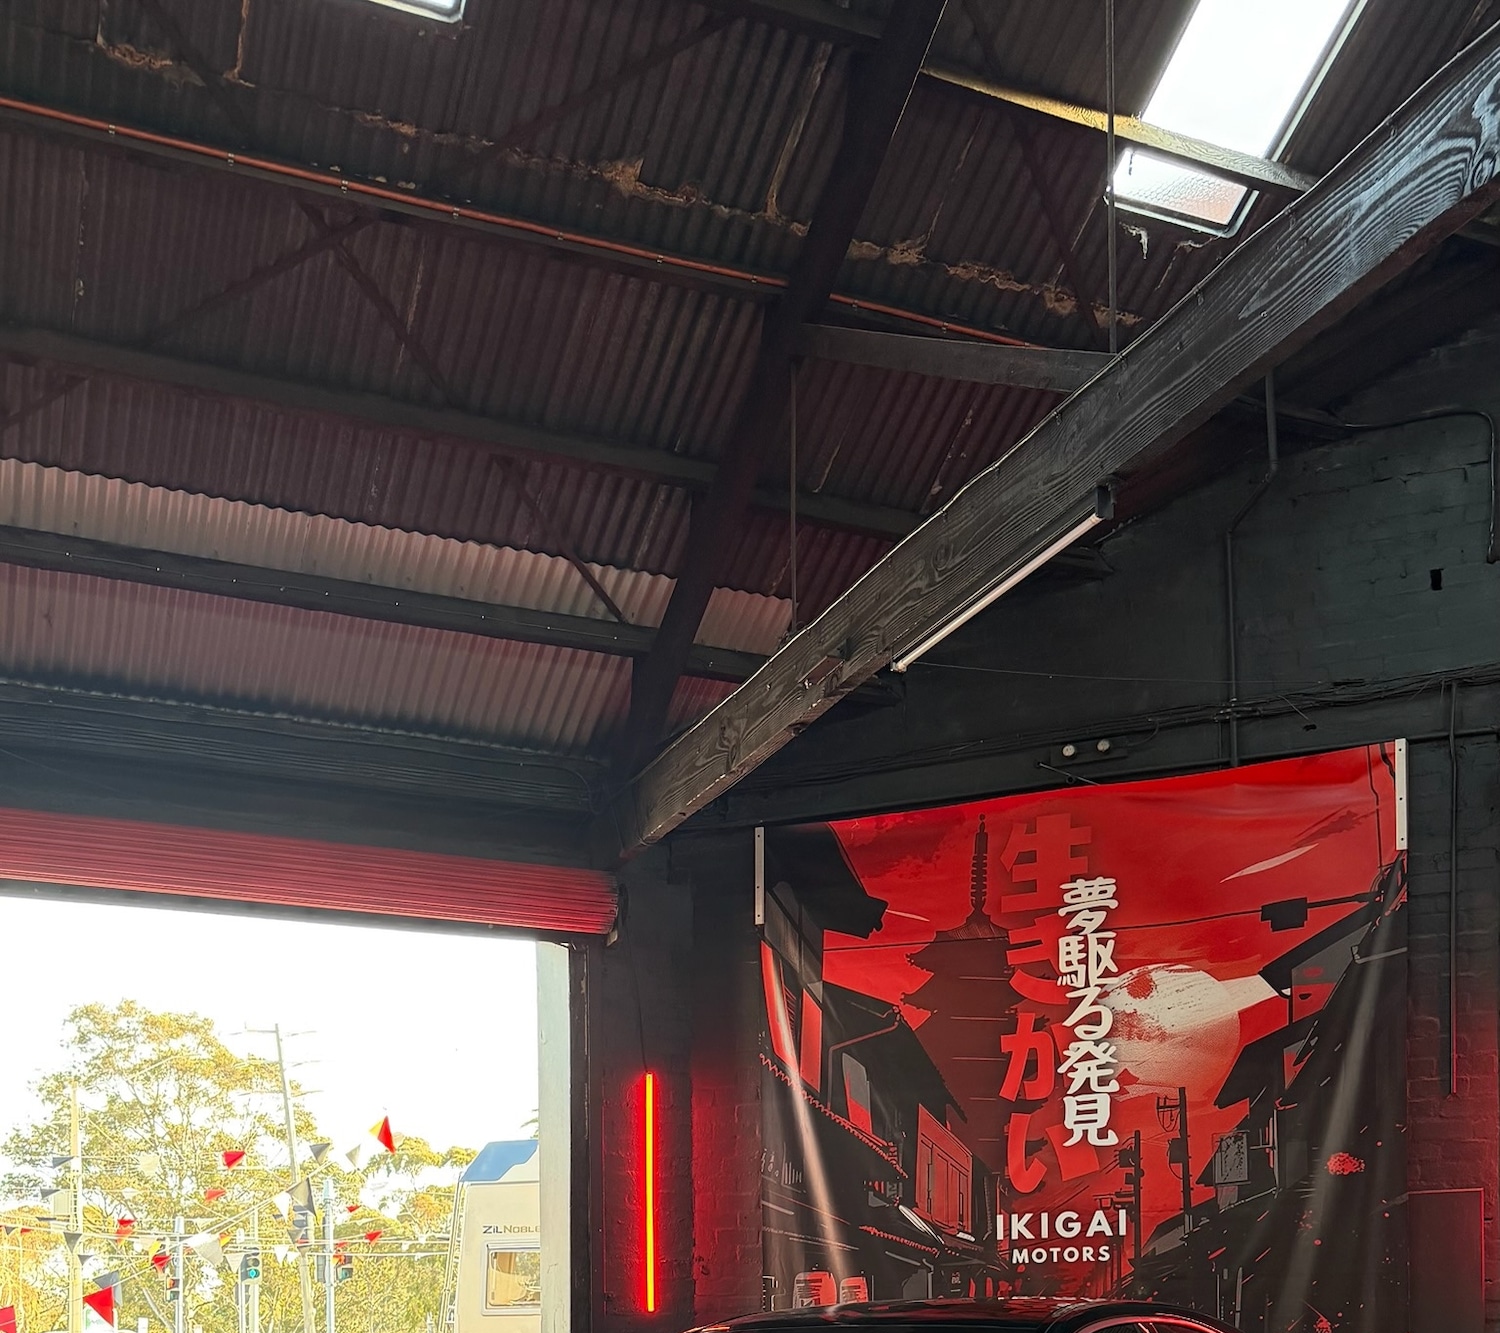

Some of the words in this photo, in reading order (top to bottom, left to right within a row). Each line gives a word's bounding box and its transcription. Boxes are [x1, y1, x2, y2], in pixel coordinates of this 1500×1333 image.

[1056, 876, 1120, 1147] 夢駆る発見
[996, 1208, 1127, 1241] IKIGAI
[1012, 1245, 1111, 1264] MOTORS
